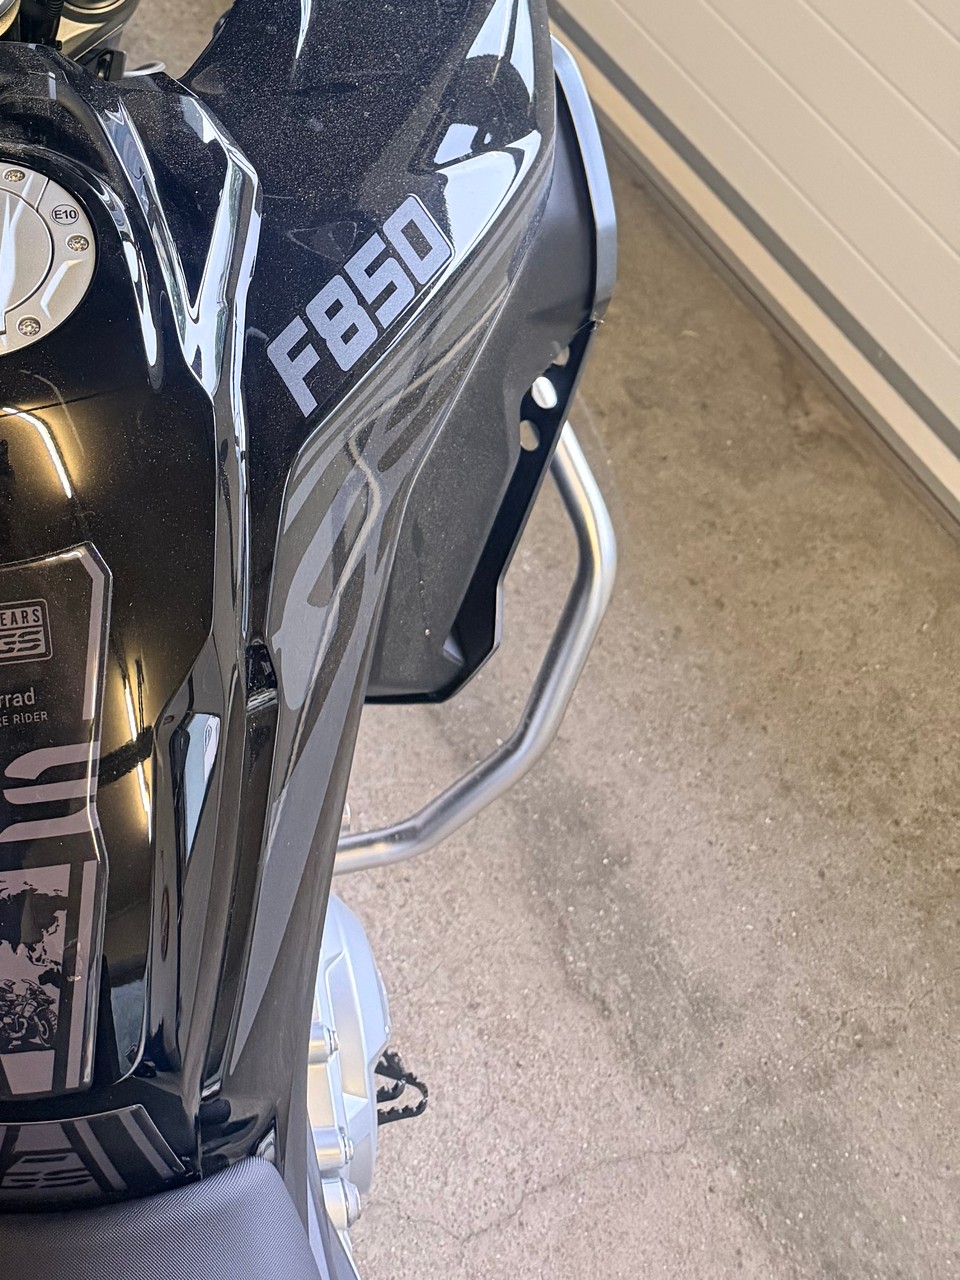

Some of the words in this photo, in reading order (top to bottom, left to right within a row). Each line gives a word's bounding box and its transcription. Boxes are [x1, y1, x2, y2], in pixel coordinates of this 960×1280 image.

[53, 209, 78, 220] E10
[266, 195, 452, 419] F850
[13, 711, 49, 724] RIDER
